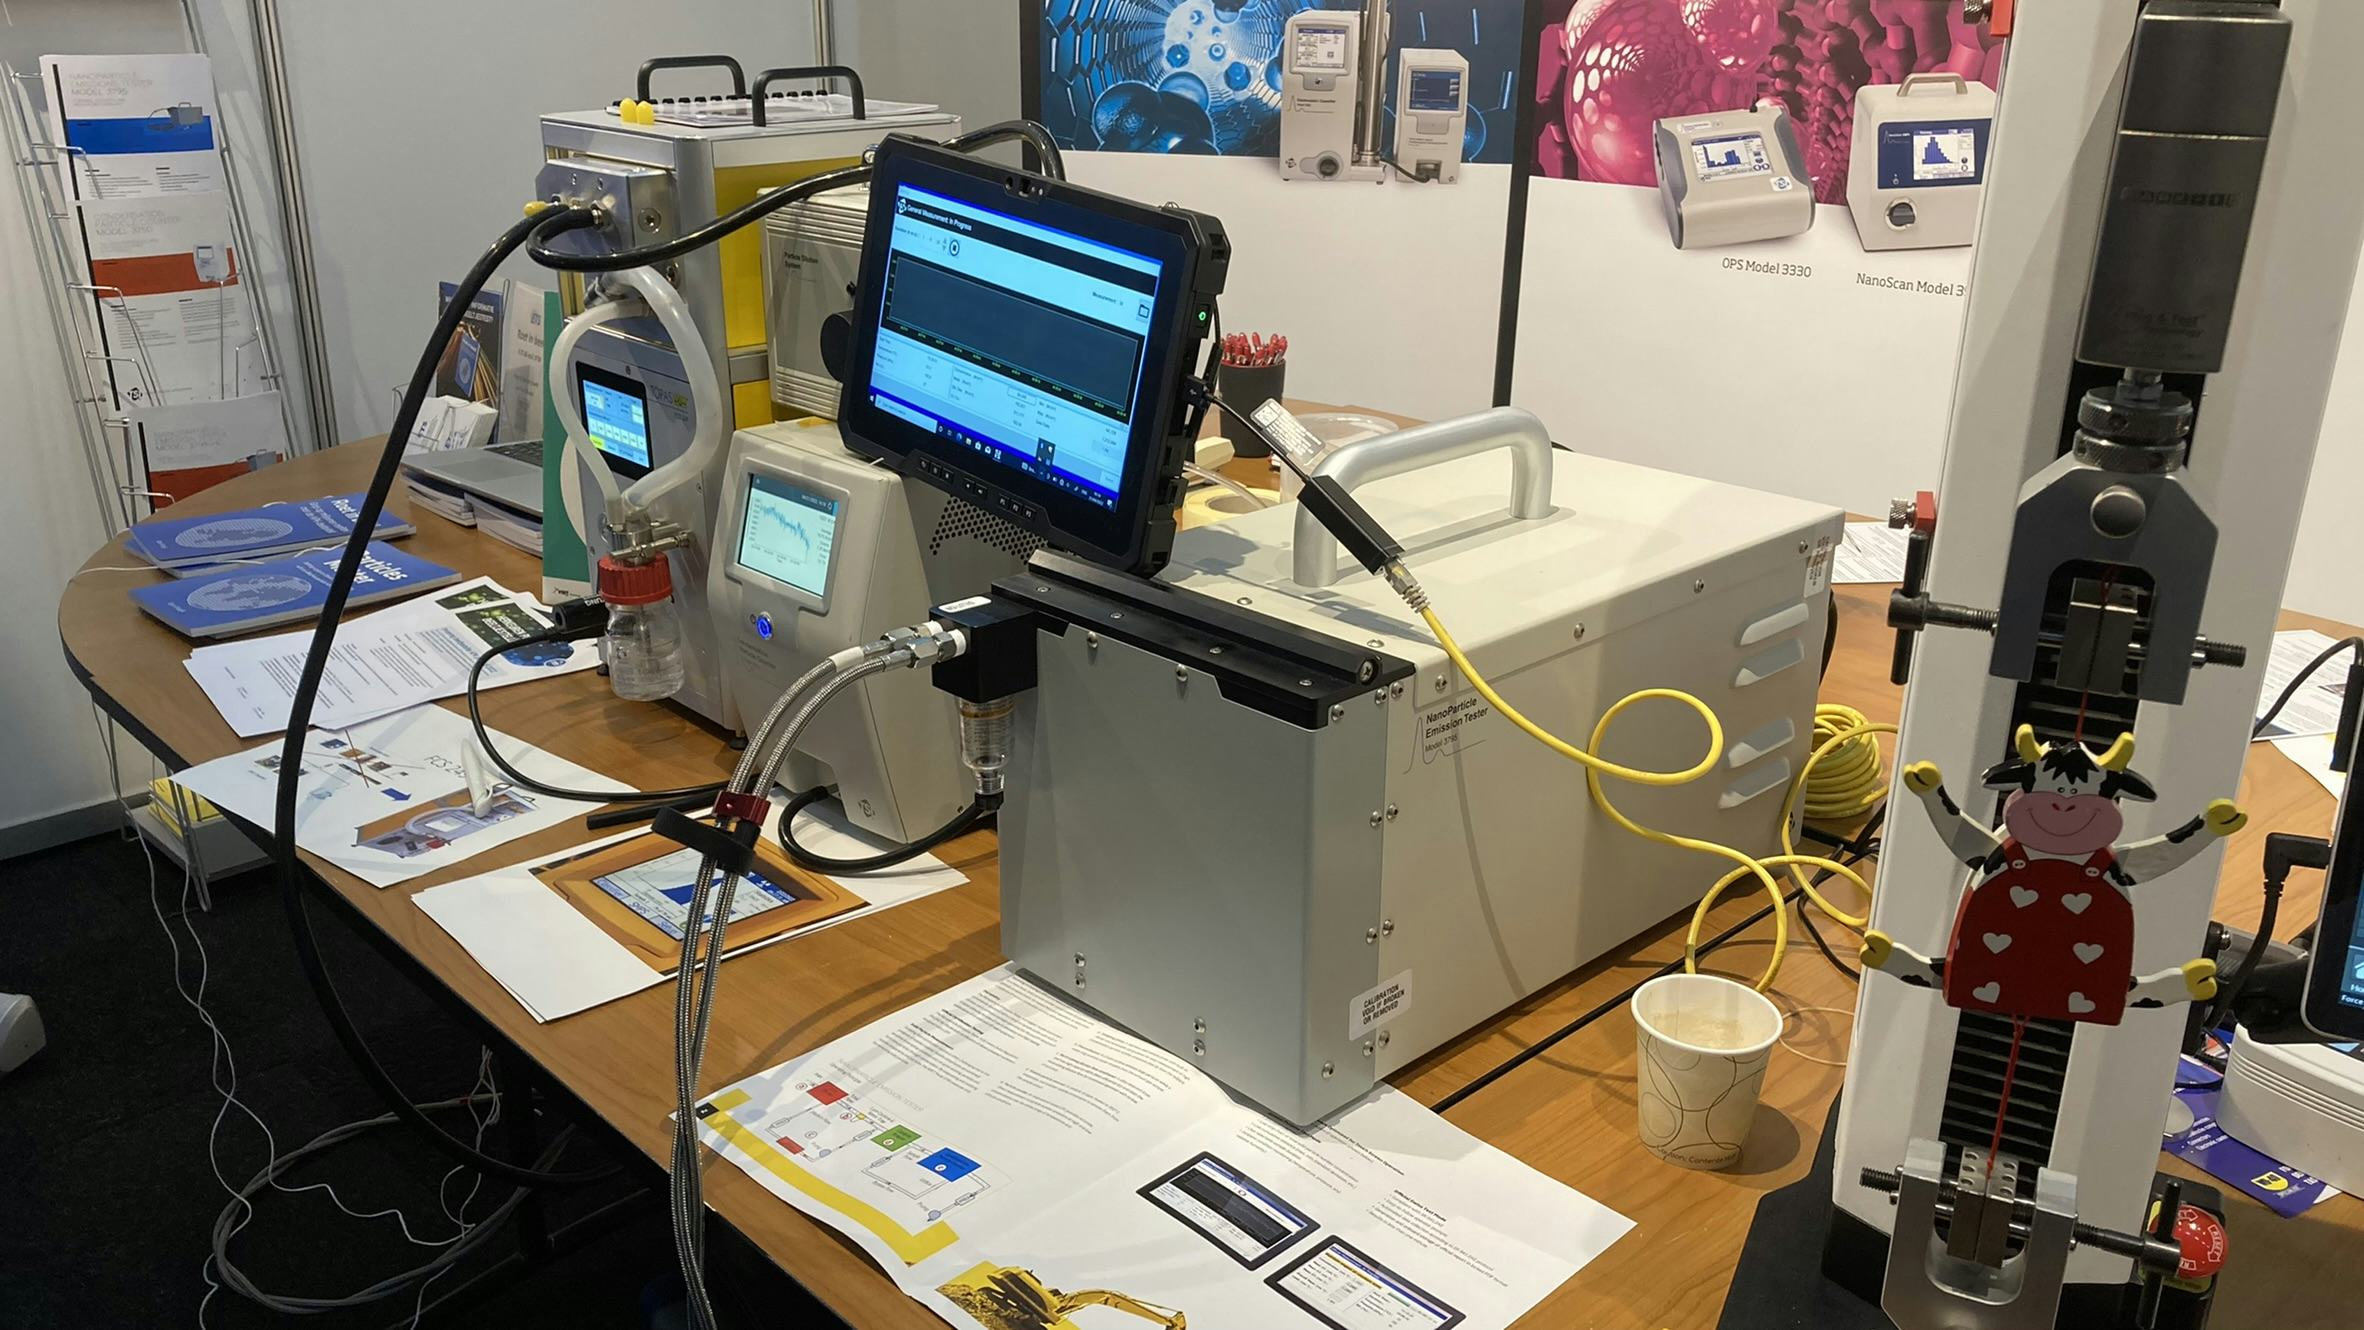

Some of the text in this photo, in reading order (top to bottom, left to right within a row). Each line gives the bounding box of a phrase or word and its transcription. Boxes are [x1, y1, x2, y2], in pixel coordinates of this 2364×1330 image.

[1722, 257, 1812, 279] OPS Model 3330
[1856, 272, 1914, 292] NanoScan
[1916, 280, 1953, 297] Model
[1424, 706, 1489, 739] Emission Tester
[1425, 697, 1478, 725] NanoParticle
[1424, 740, 1443, 753] Model
[1362, 989, 1405, 1018] VOID IF BROKEN
[1363, 984, 1399, 1008] CALIBRATION
[2341, 994, 2364, 1006] Force
[1363, 1000, 1399, 1025] OR REMOVED
